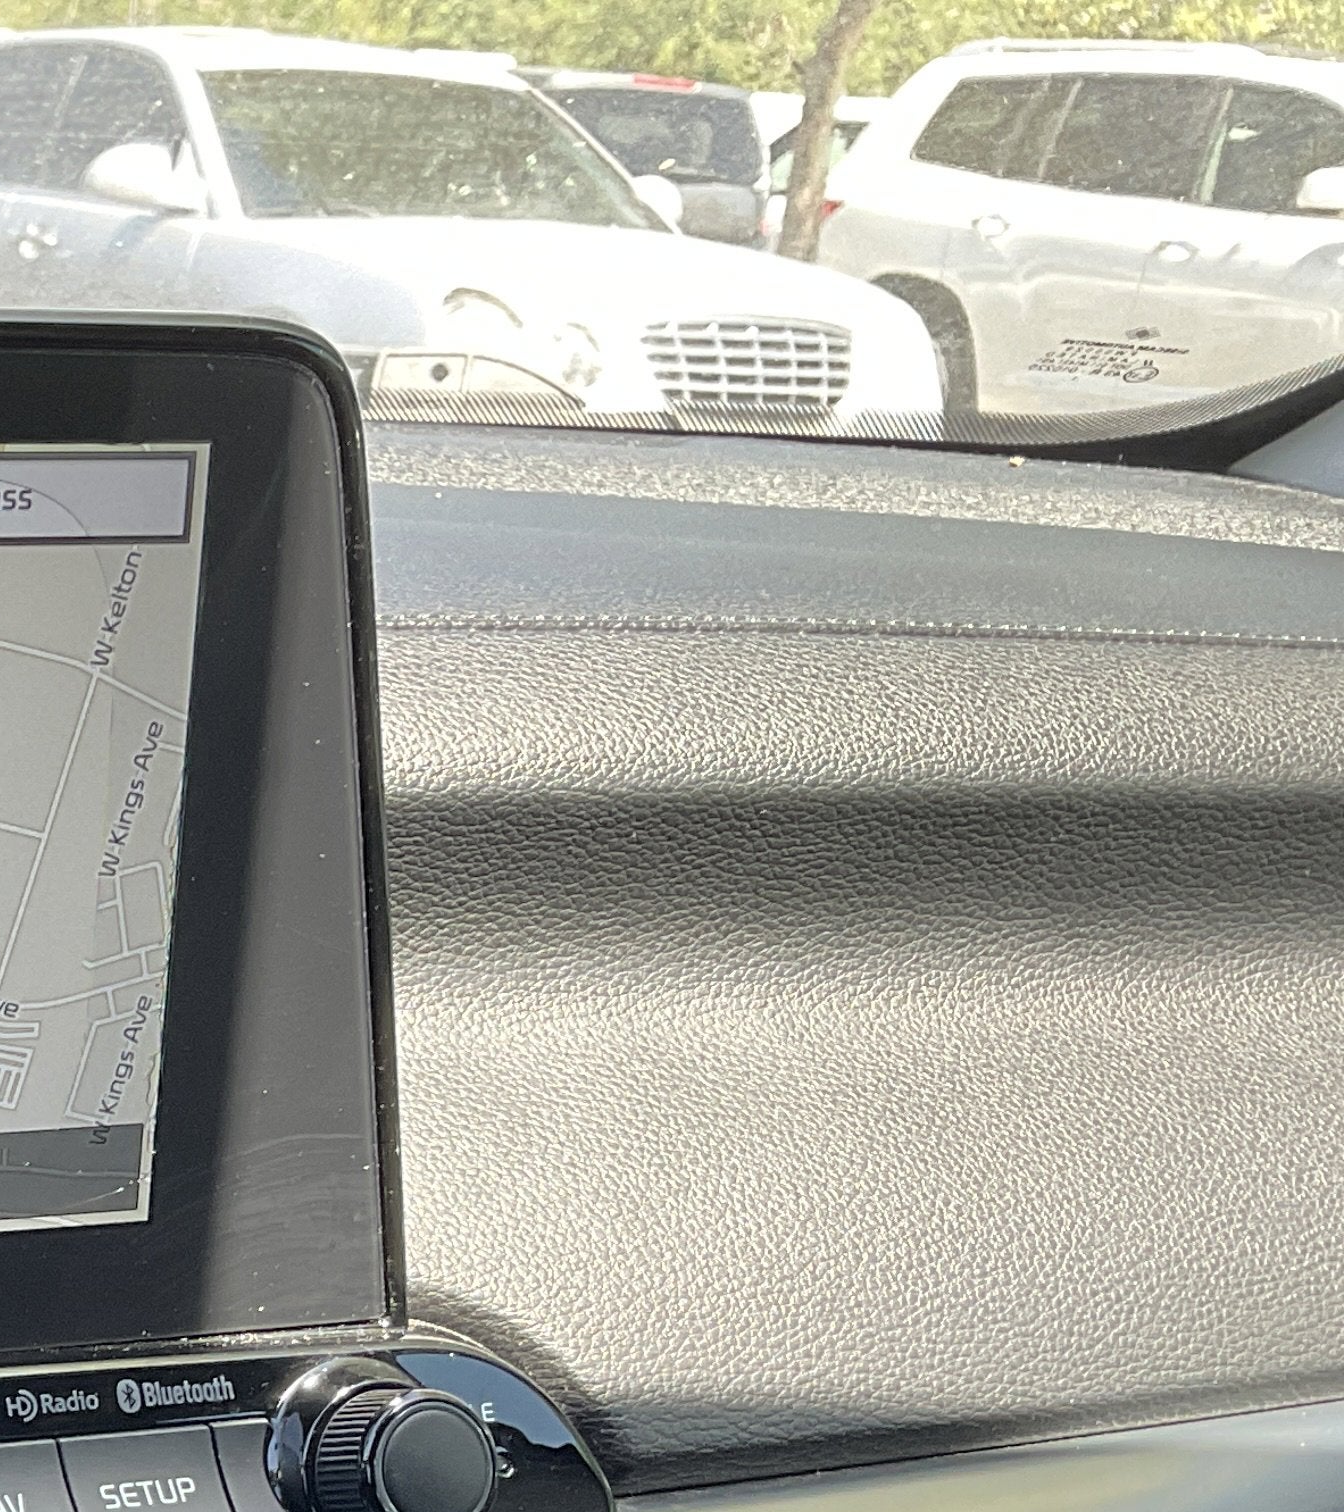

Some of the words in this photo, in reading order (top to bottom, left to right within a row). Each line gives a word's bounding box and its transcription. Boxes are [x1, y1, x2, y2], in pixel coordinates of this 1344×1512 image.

[90, 639, 113, 667] W
[102, 549, 143, 635] Kelton
[133, 721, 163, 773] Ave
[107, 776, 145, 847] Kings
[98, 852, 120, 879] W
[123, 995, 153, 1043] Ave
[98, 1046, 136, 1115] Kings
[89, 1120, 112, 1146] W
[40, 1391, 100, 1414] Radio
[142, 1375, 235, 1408] Bluetooth
[99, 1477, 196, 1510] SETUP
